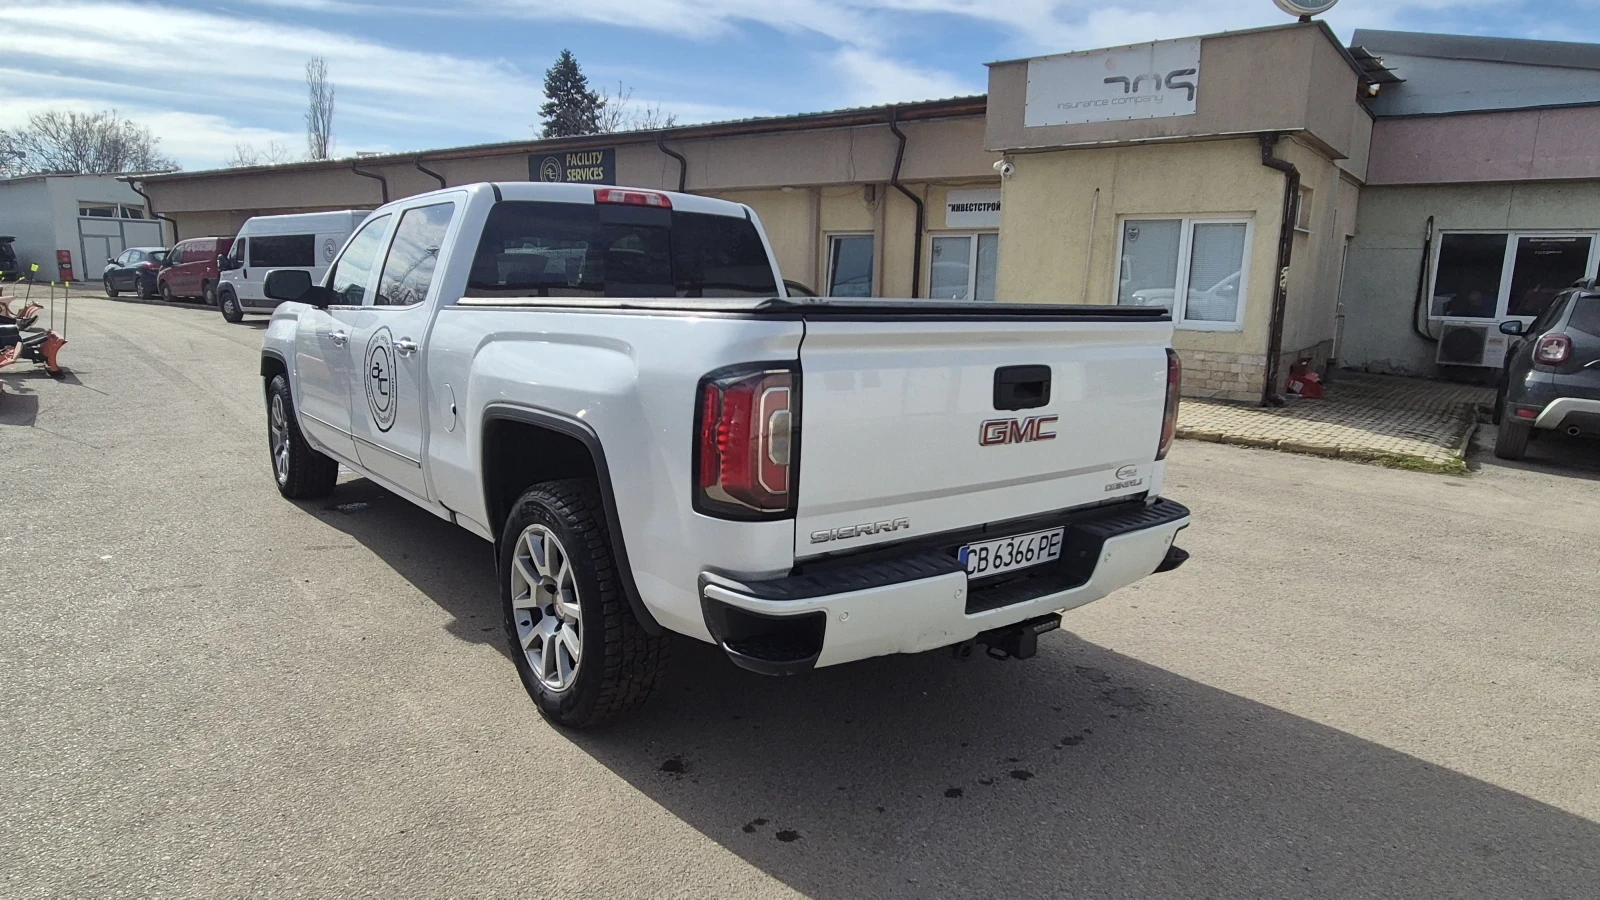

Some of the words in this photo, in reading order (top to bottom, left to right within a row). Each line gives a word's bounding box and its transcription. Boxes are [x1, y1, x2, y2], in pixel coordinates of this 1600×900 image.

[1057, 98, 1109, 110] insurance
[1111, 94, 1164, 106] company
[566, 151, 603, 167] FACILITY
[566, 167, 604, 182] SERVICES
[979, 414, 1059, 446] GMC
[810, 517, 910, 544] SIERRA
[967, 546, 989, 575] CB
[993, 537, 1035, 569] 6366
[1037, 532, 1061, 560] PE
